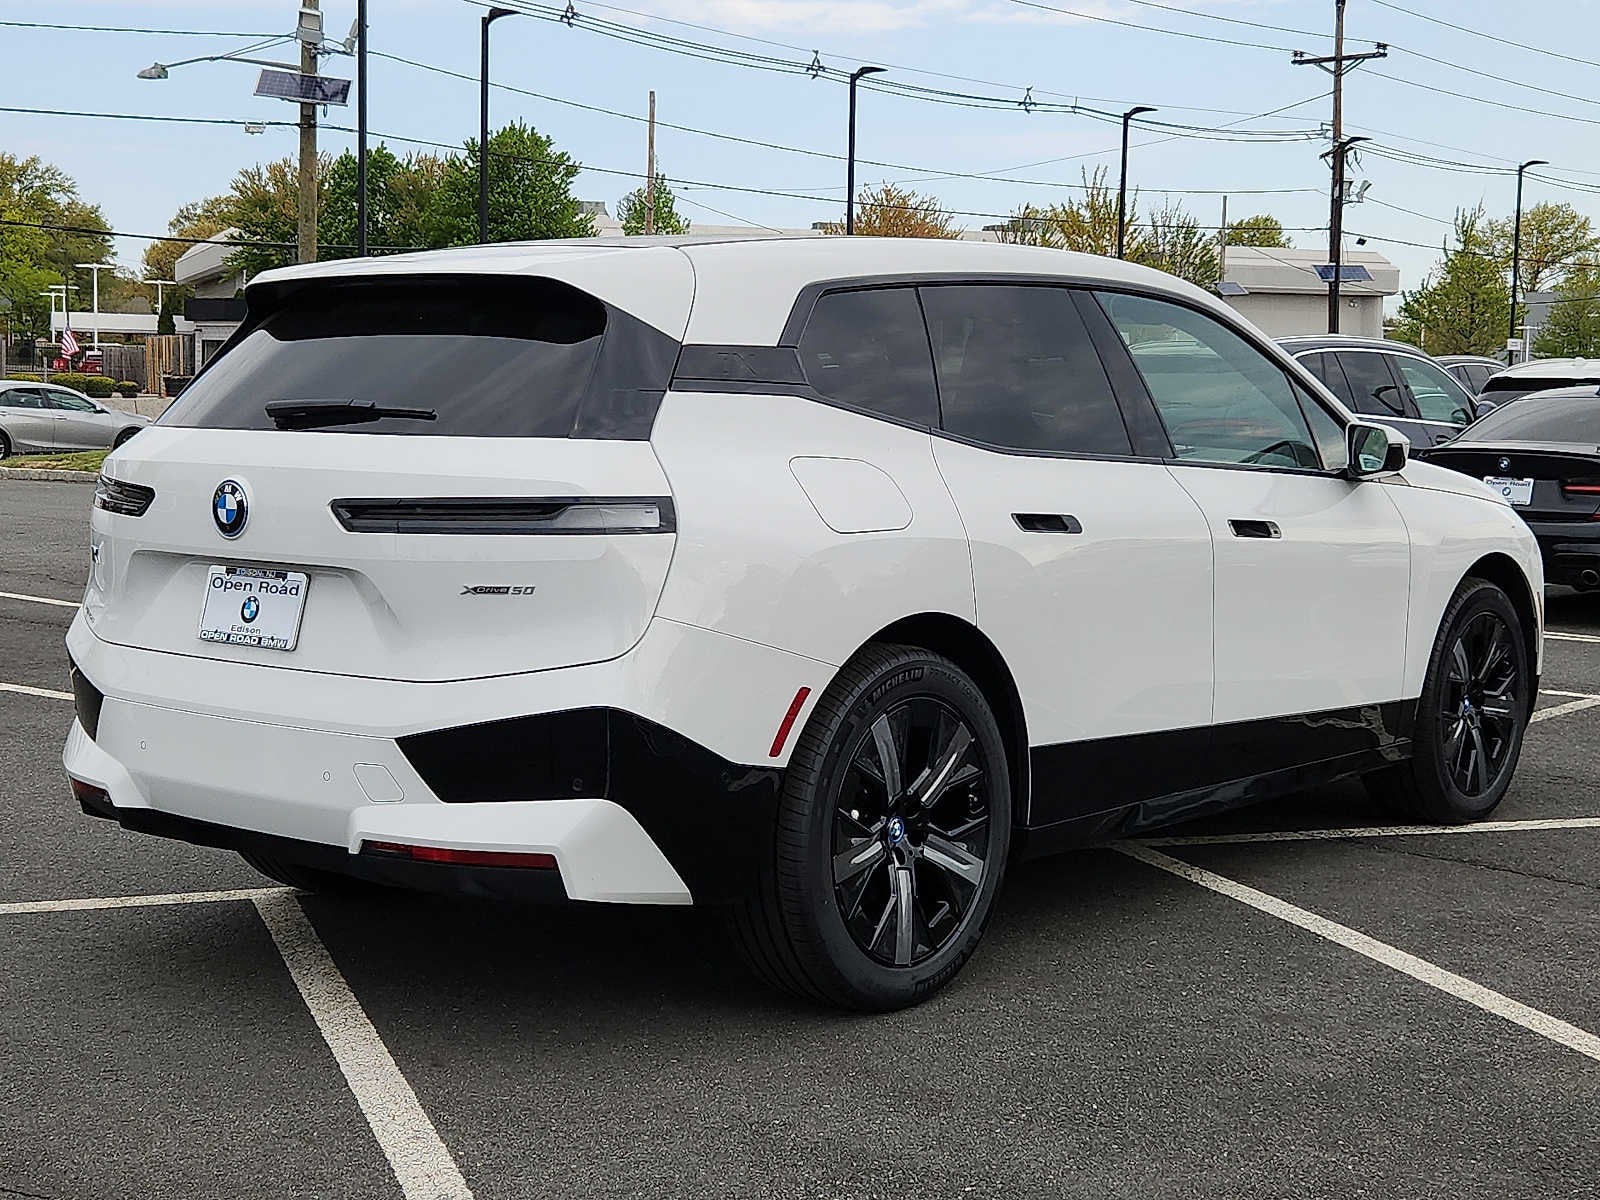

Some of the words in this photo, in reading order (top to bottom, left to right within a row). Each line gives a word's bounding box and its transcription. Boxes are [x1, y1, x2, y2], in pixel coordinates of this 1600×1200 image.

[212, 576, 253, 592] Open
[258, 581, 300, 596] Road
[230, 624, 261, 635] Edison
[201, 630, 228, 641] OPEN
[229, 634, 259, 645] ROAD
[260, 639, 288, 649] BMW
[871, 667, 924, 702] MICHELIN
